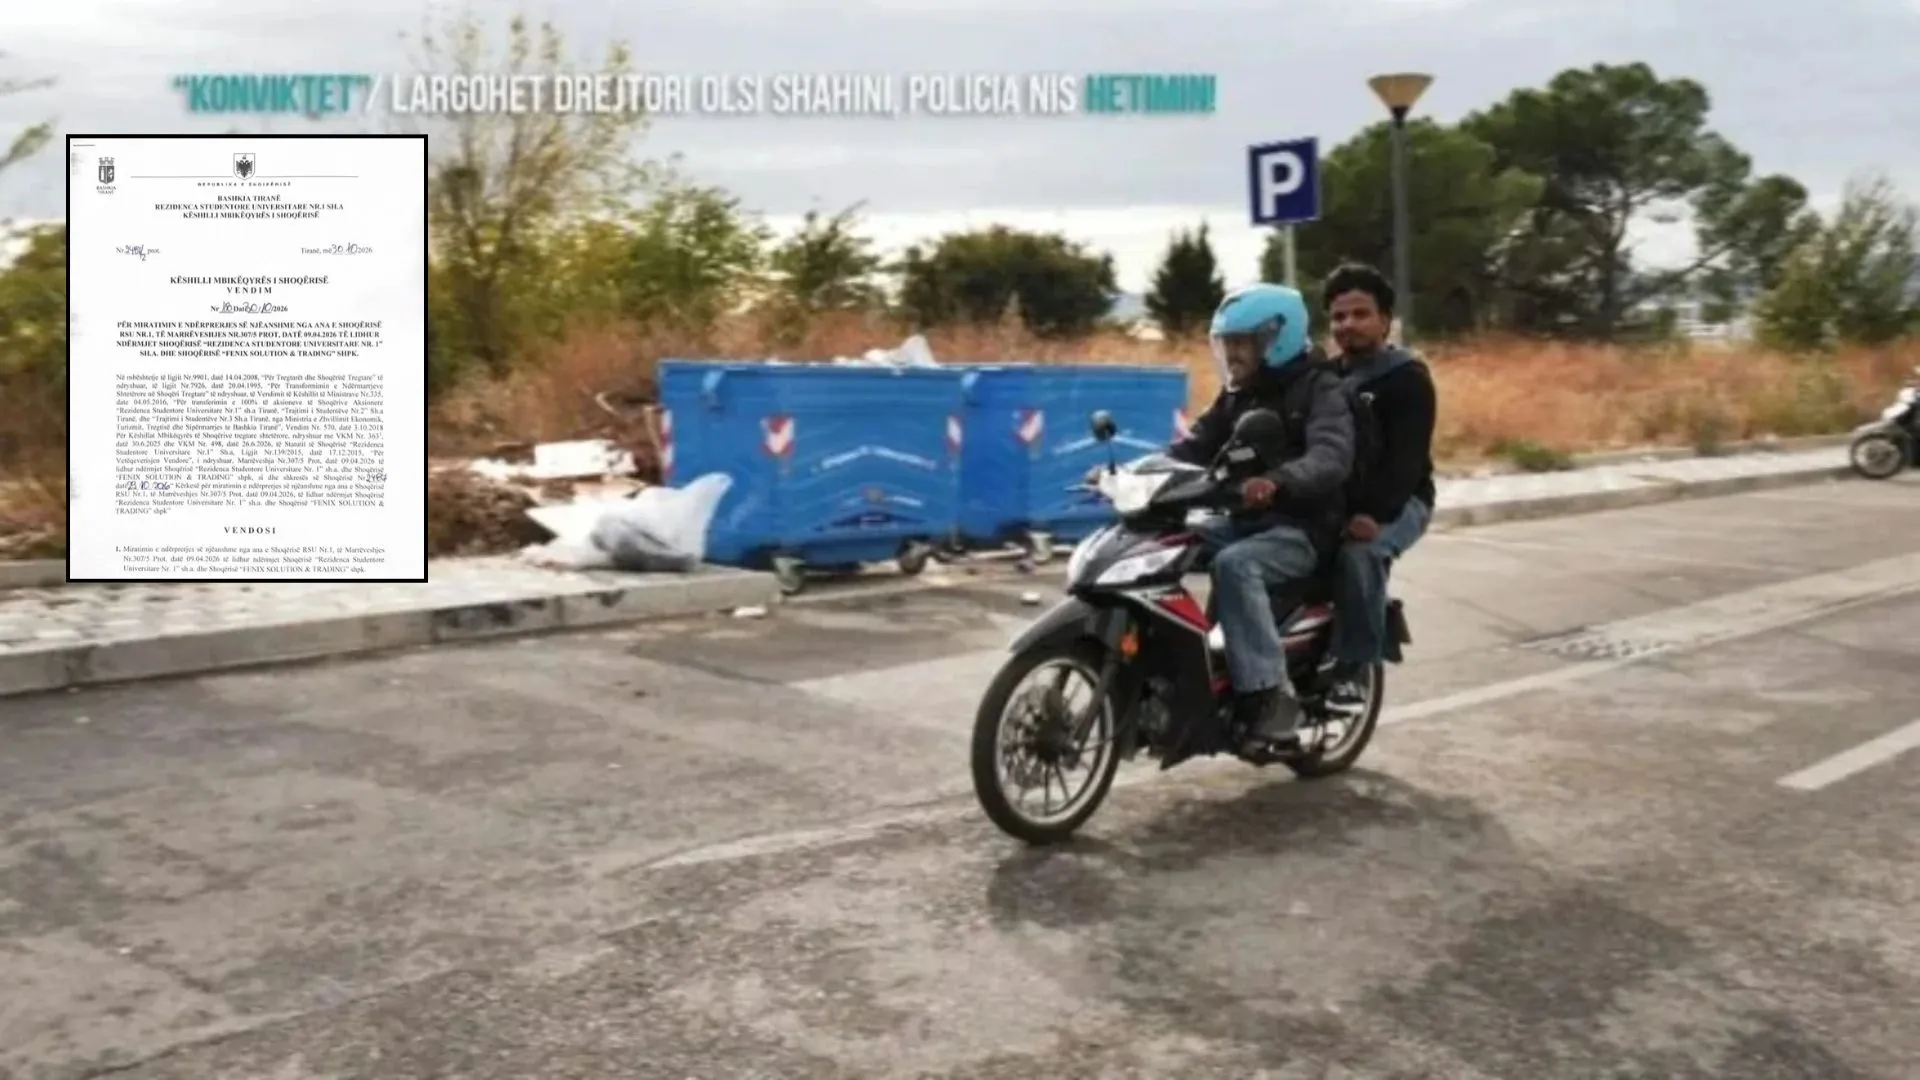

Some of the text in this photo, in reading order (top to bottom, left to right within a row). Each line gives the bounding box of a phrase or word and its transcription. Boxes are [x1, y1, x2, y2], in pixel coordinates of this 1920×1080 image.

[1260, 151, 1305, 218] P
[221, 210, 270, 219] MBIKËQYRËS
[276, 210, 319, 219] SHOQËRISË
[170, 275, 212, 284] KËSHILLI
[214, 275, 272, 285] MBIKËQYRËS
[279, 275, 328, 285] SHOQËRISË
[338, 320, 381, 329] SHOQËRISË
[159, 339, 202, 348] SHOQËRISË
[178, 348, 220, 357] SHOQËRISË
